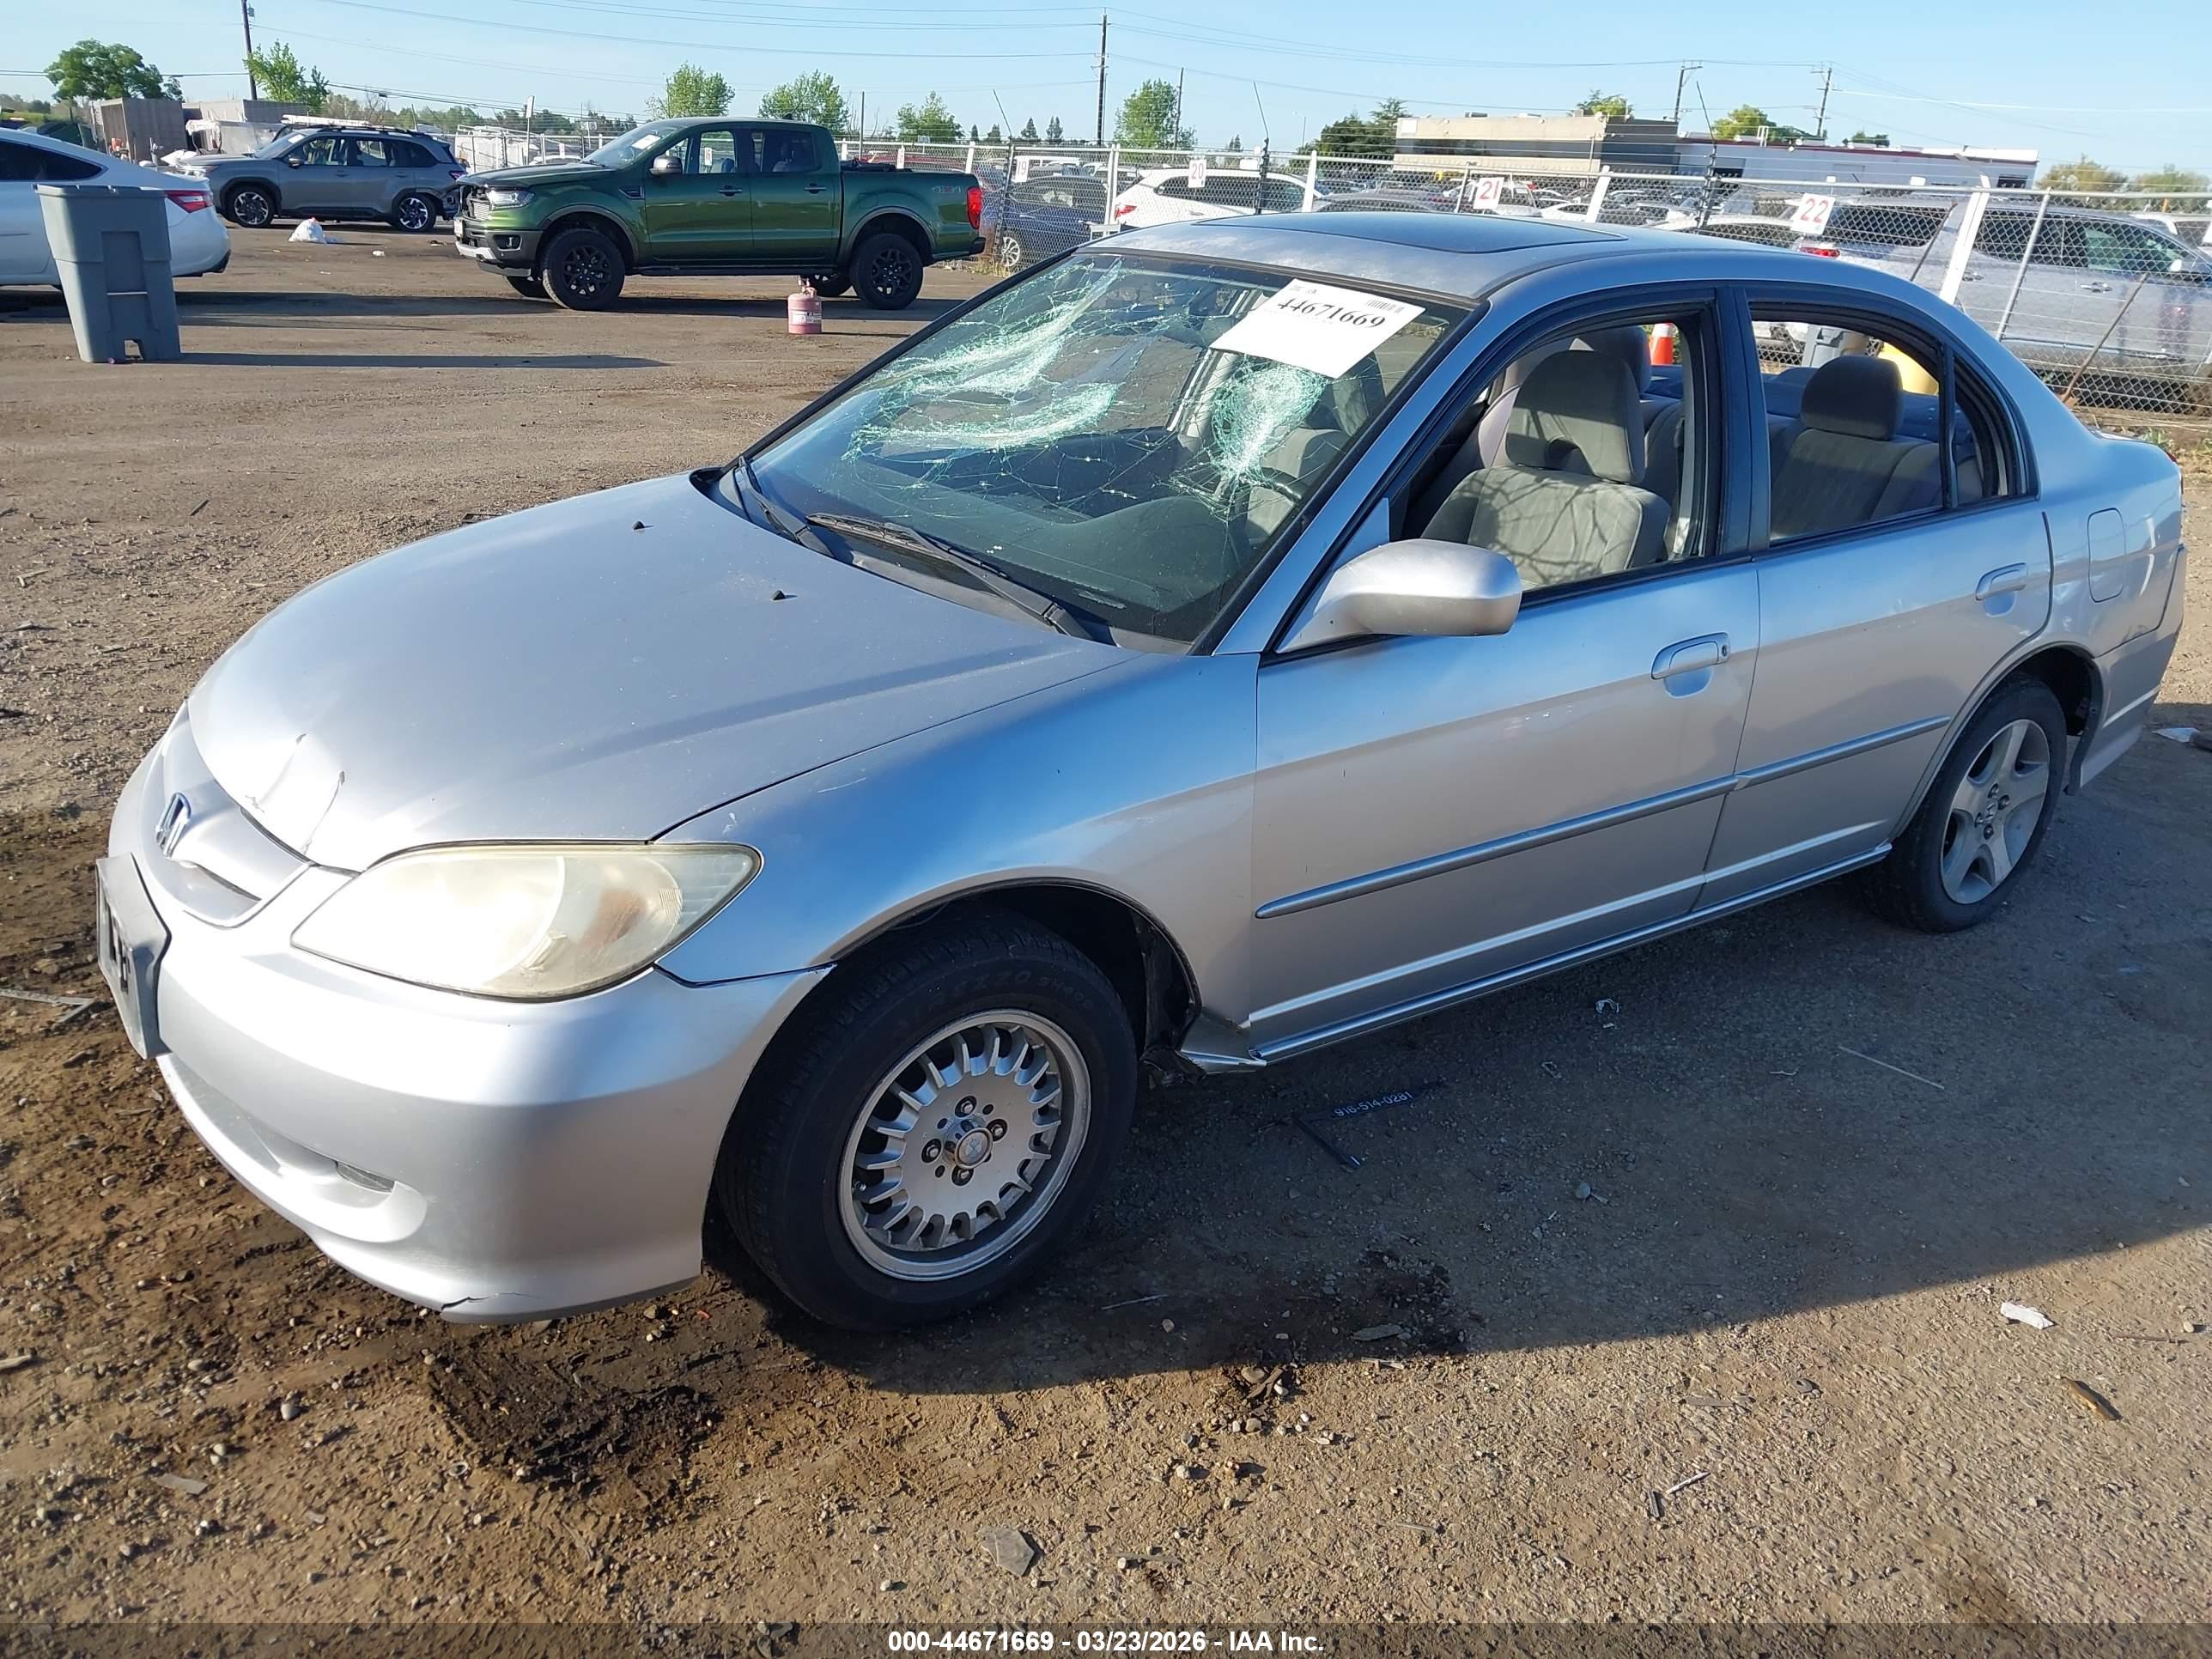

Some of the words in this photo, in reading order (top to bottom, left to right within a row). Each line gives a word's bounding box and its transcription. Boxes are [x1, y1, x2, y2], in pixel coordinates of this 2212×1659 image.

[1017, 160, 1027, 175] 19
[1191, 163, 1204, 179] 20
[1478, 180, 1499, 199] 21
[1800, 198, 1828, 222] 22
[1277, 297, 1386, 328] 44671669
[1334, 1091, 1413, 1116] 916-514-0281
